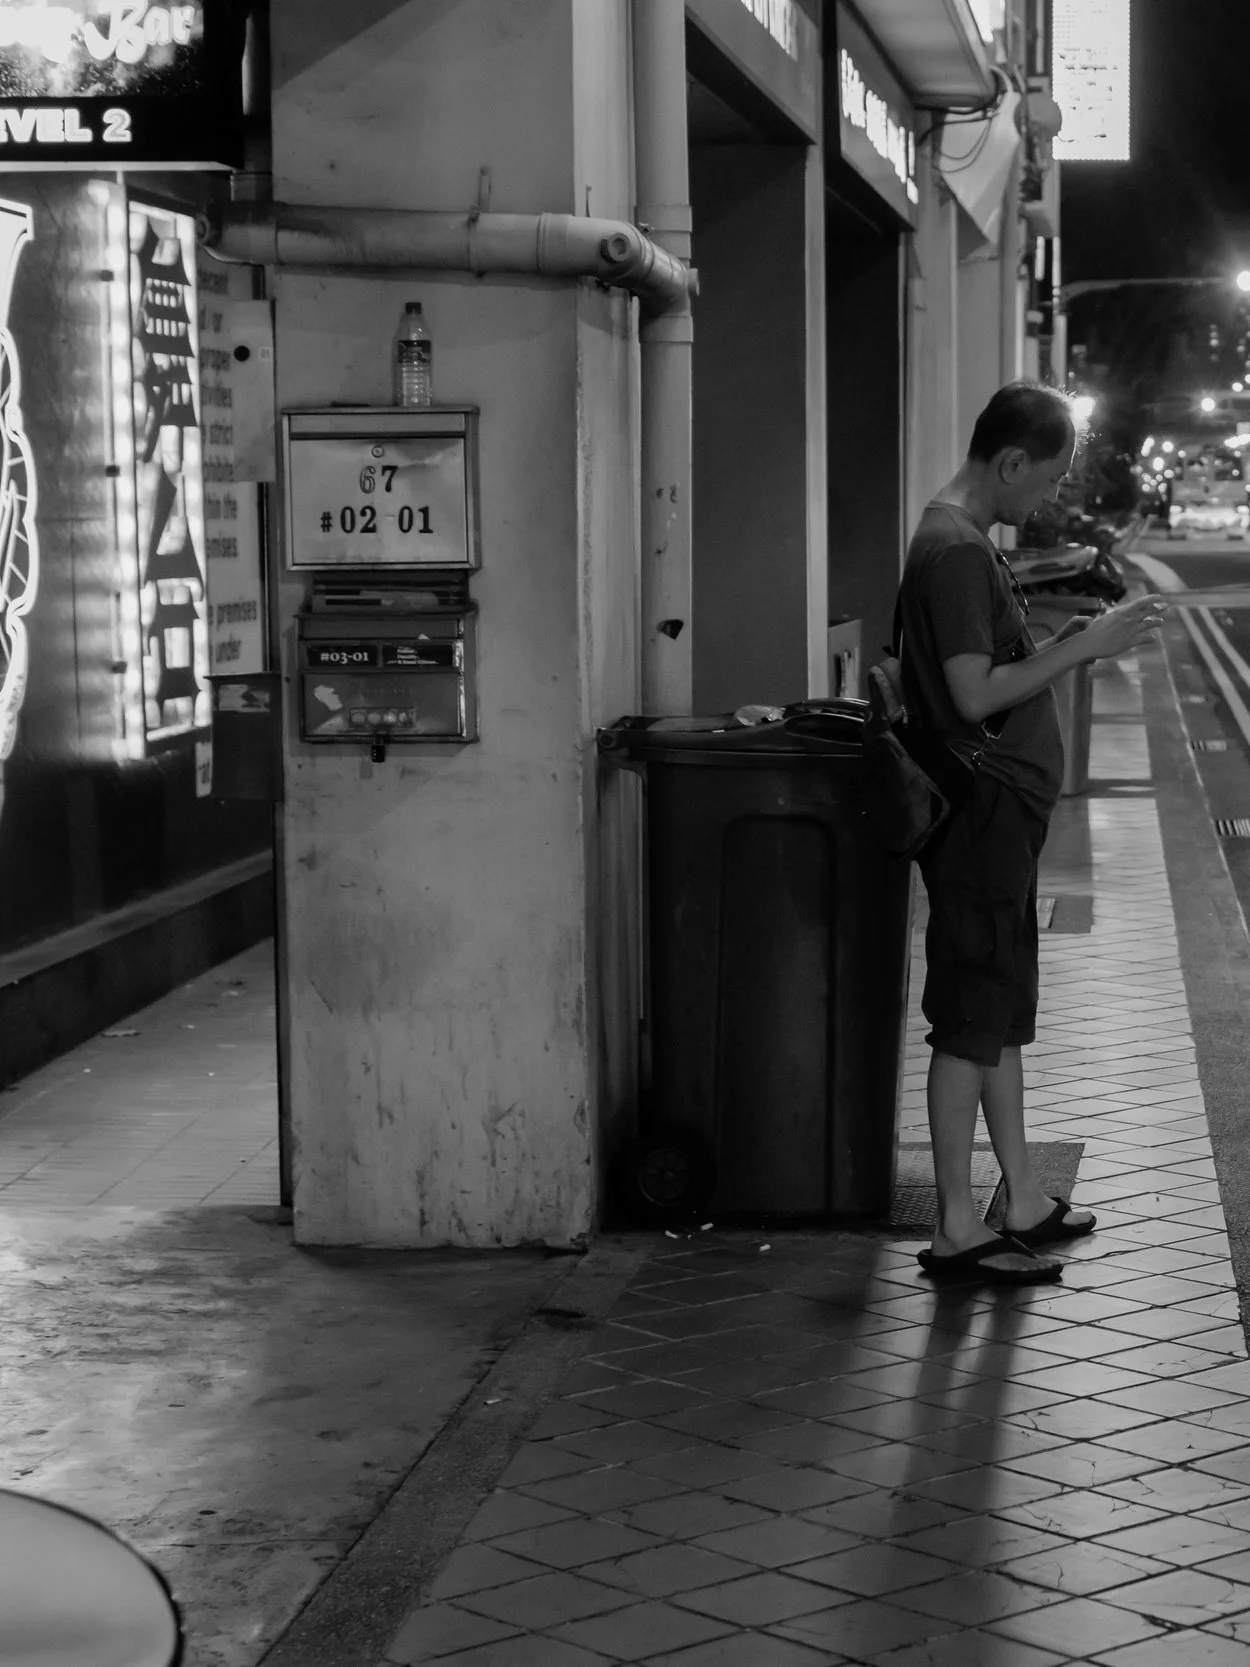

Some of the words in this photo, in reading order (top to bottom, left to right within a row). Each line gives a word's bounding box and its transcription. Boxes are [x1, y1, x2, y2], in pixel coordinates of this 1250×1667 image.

[102, 108, 132, 143] 2
[359, 464, 399, 494] 67
[320, 651, 369, 665] #03-01
